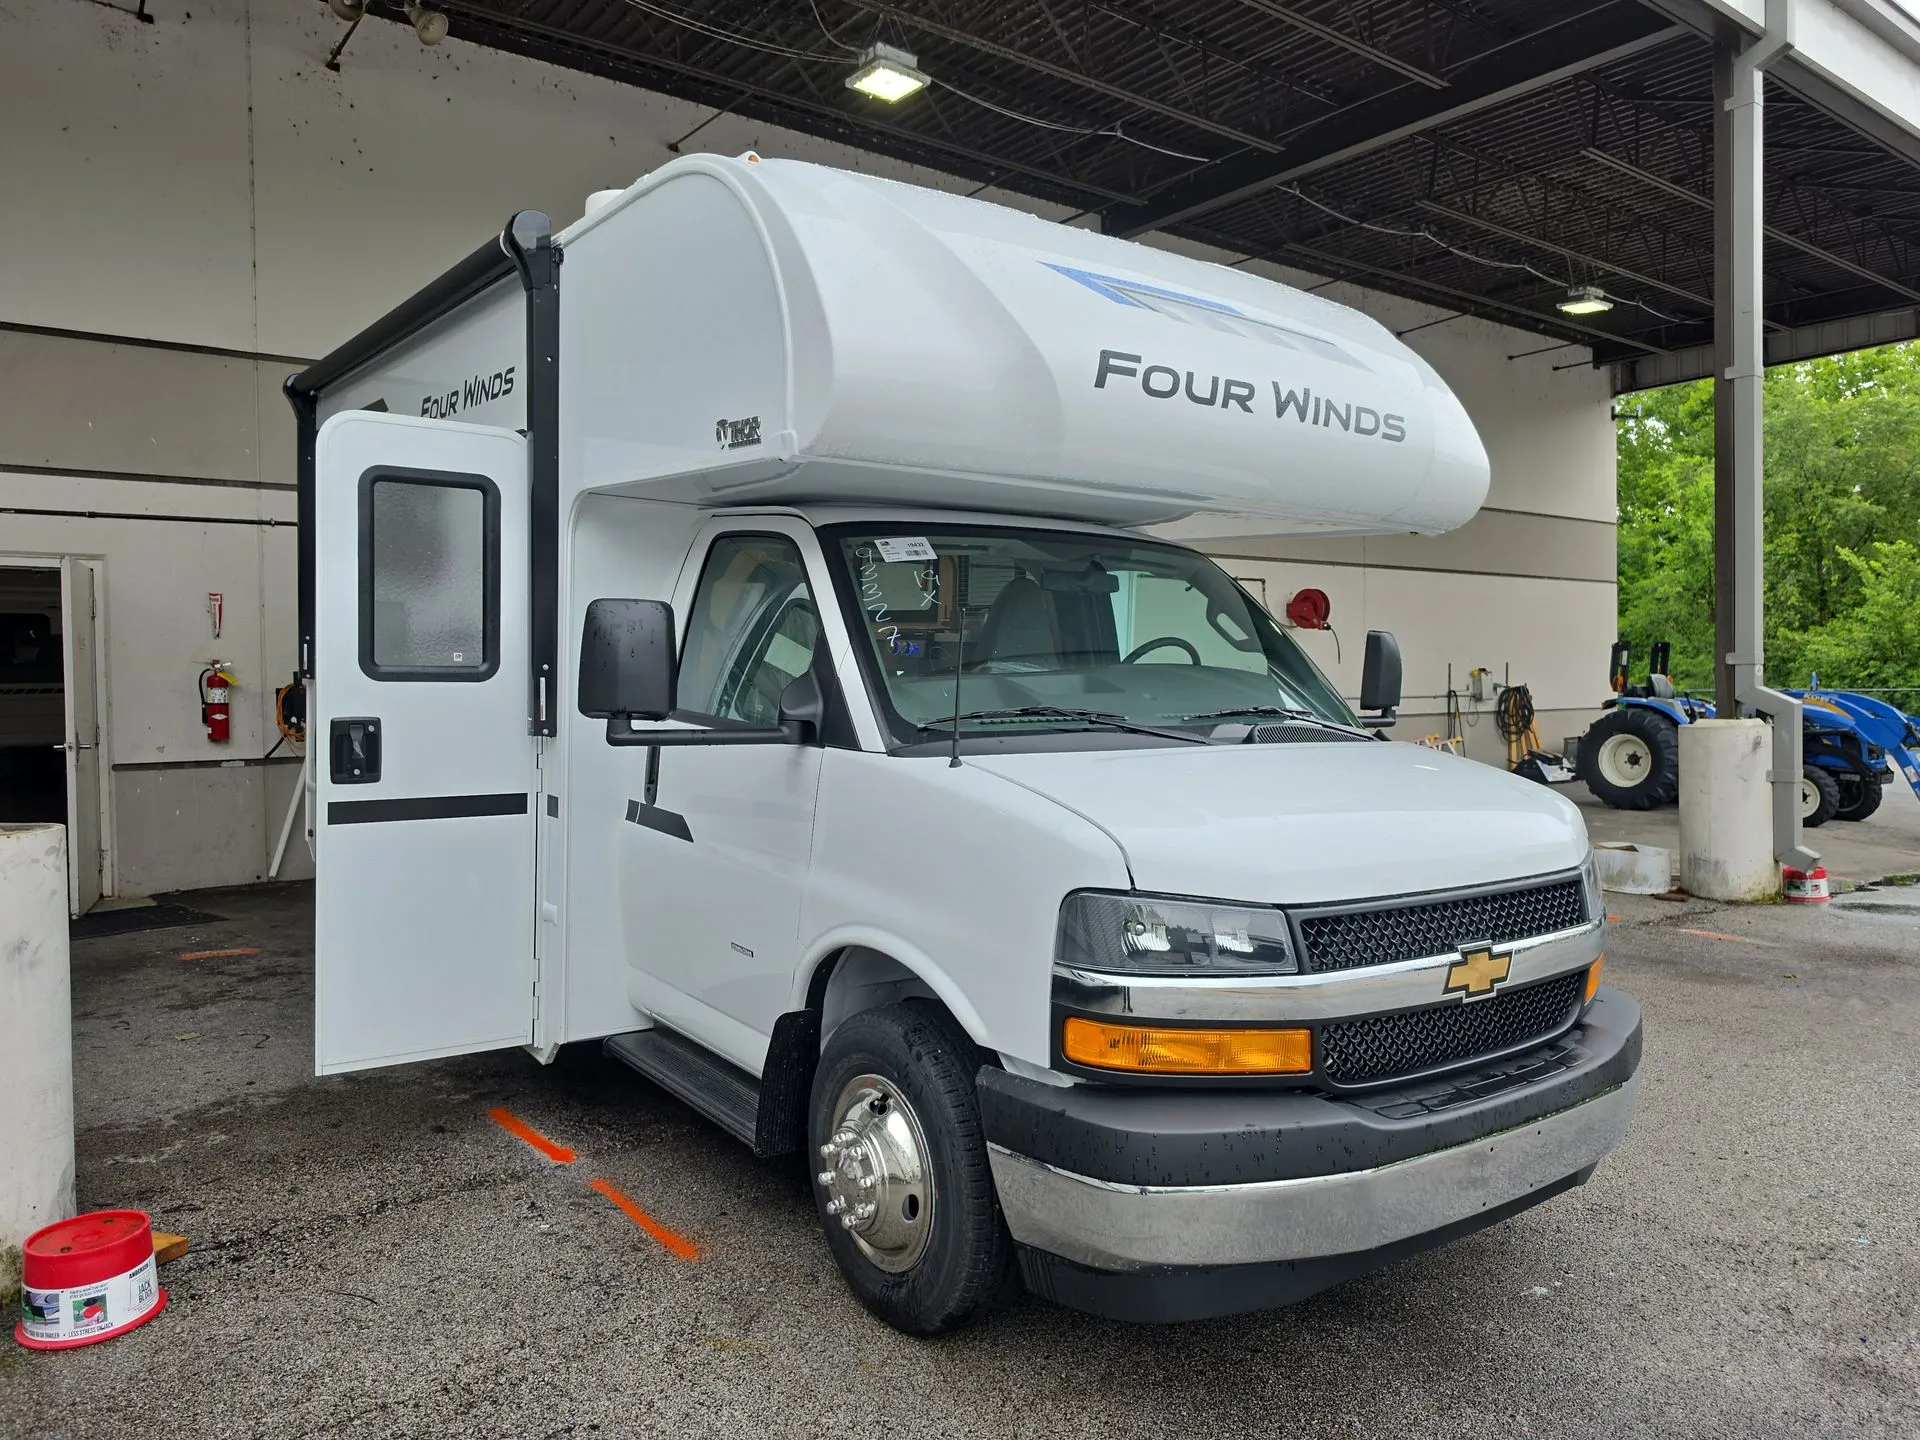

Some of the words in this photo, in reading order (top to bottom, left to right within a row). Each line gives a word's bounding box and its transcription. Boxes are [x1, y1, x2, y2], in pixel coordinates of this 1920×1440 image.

[420, 389, 460, 419] FOUR
[463, 366, 516, 411] WINDS
[1093, 348, 1256, 414] FOUR
[1271, 380, 1407, 443] WINDS
[728, 416, 761, 443] THOR
[138, 1279, 151, 1296] JACK
[138, 1288, 153, 1304] BLOCK
[79, 1326, 96, 1336] STRESS
[102, 1321, 113, 1330] JACK
